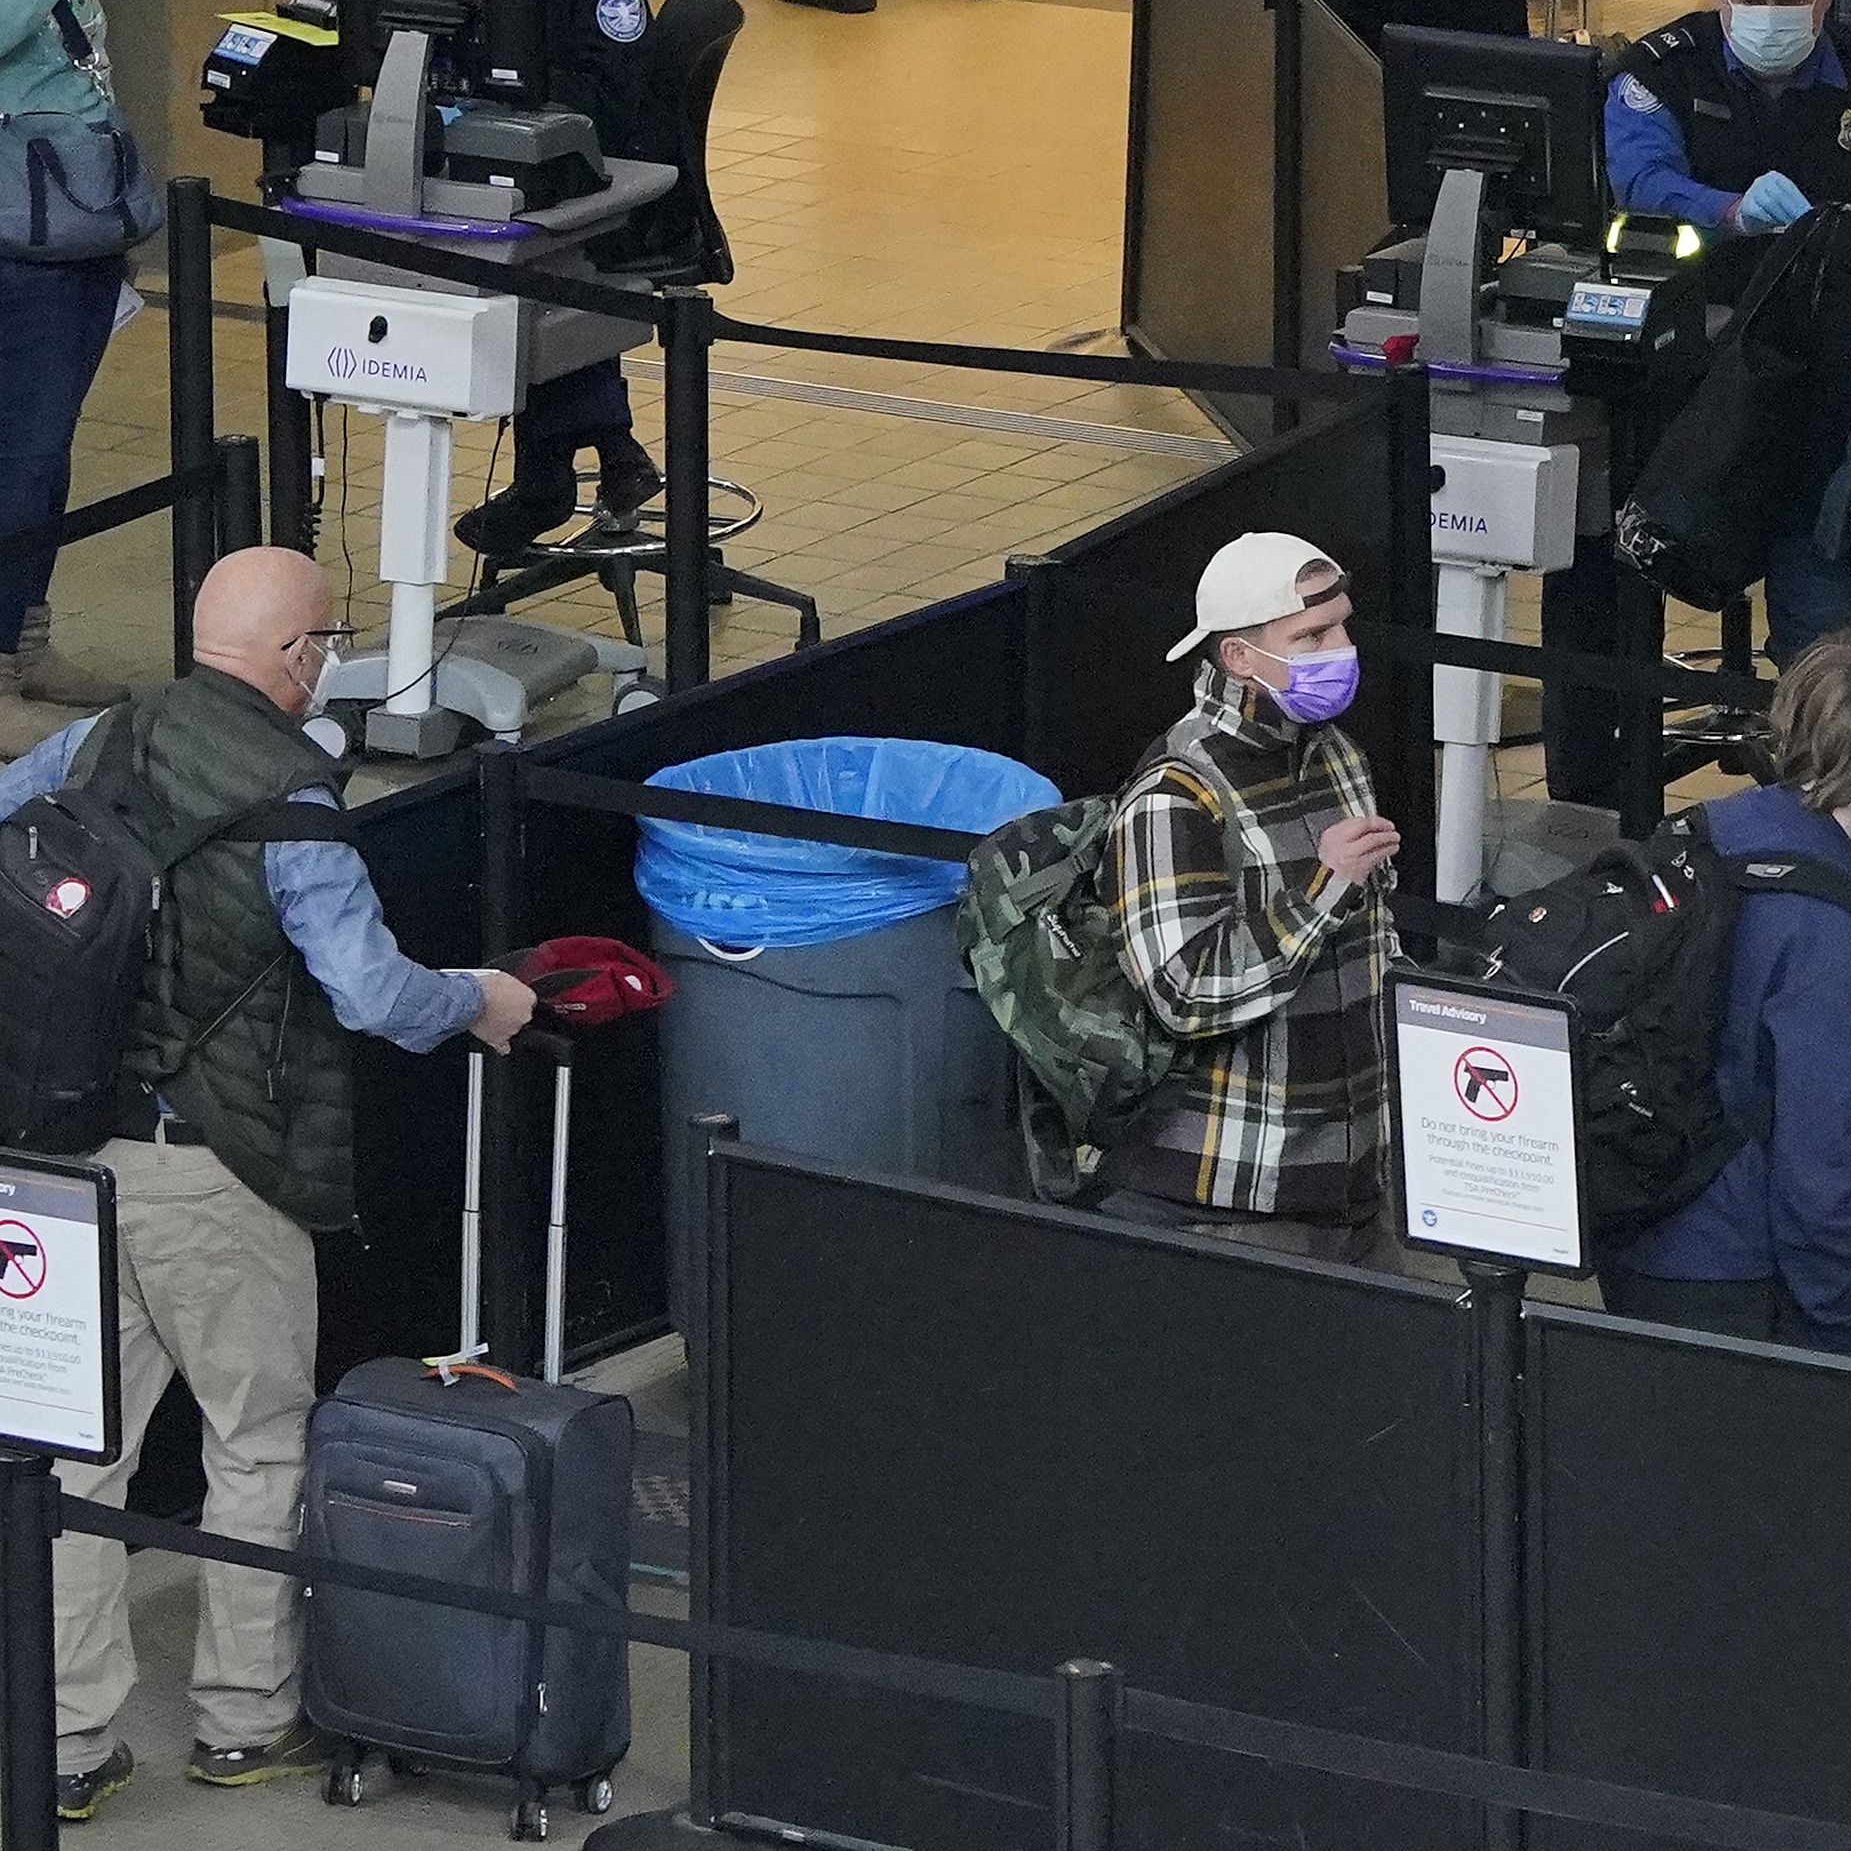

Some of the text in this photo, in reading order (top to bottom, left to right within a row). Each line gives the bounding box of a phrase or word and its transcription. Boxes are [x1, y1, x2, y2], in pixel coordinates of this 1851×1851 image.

[361, 357, 428, 384] IDEMIA
[1430, 511, 1488, 535] DEMIA
[1409, 999, 1486, 1025] Travel Advisory
[1421, 1117, 1558, 1151] Do not bring your firearm
[1428, 1132, 1553, 1166] through the checkpoint.
